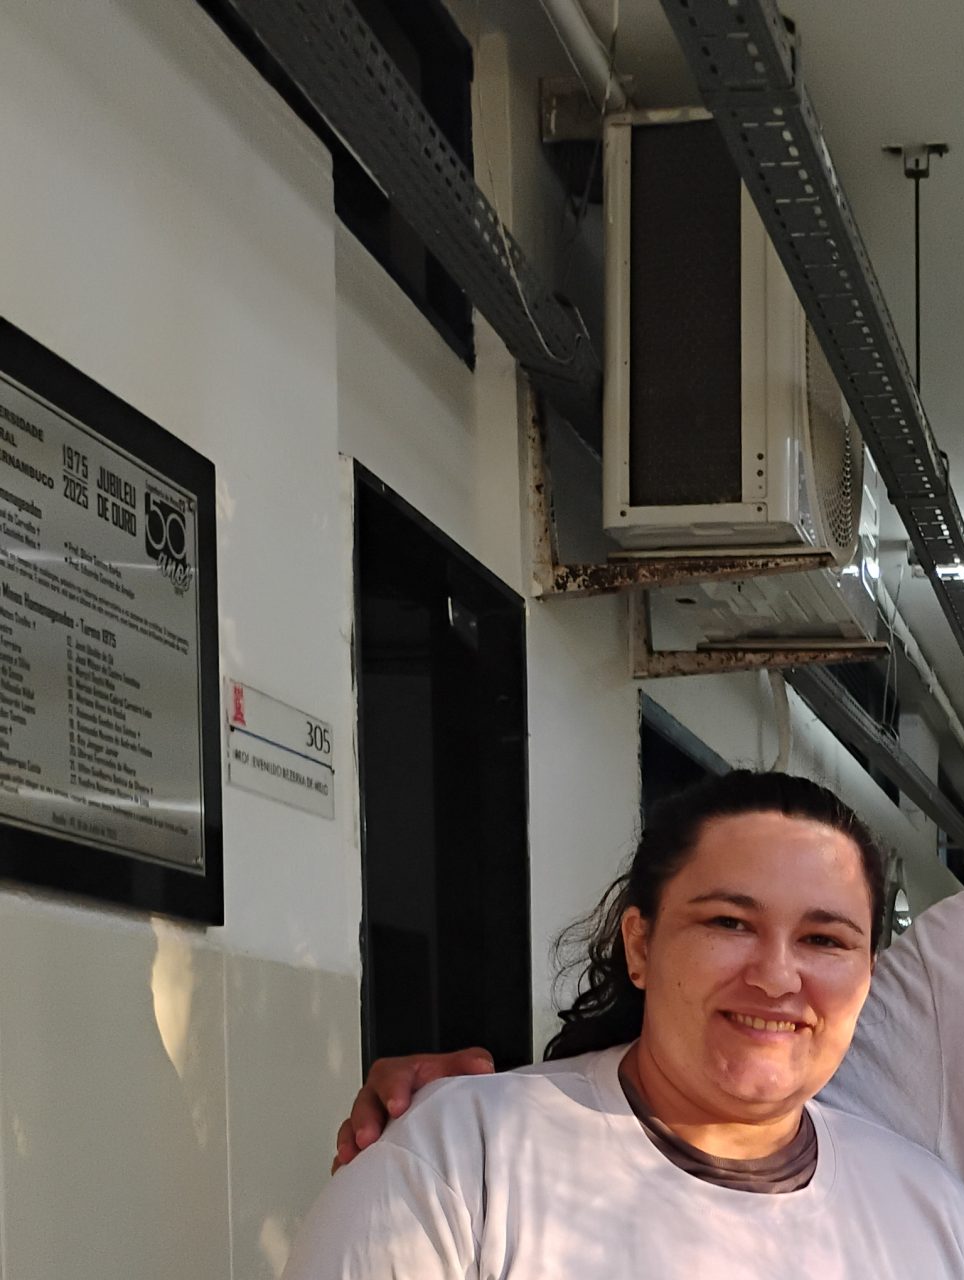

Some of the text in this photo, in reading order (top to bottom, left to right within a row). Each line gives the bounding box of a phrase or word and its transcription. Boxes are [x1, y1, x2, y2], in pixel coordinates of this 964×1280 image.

[62, 443, 89, 479] 1975
[63, 474, 89, 510] 2025
[97, 465, 136, 510] JUBILEU
[97, 493, 110, 521] DE
[112, 502, 137, 537] OURO
[145, 491, 186, 560] 50
[305, 720, 331, 755] 305
